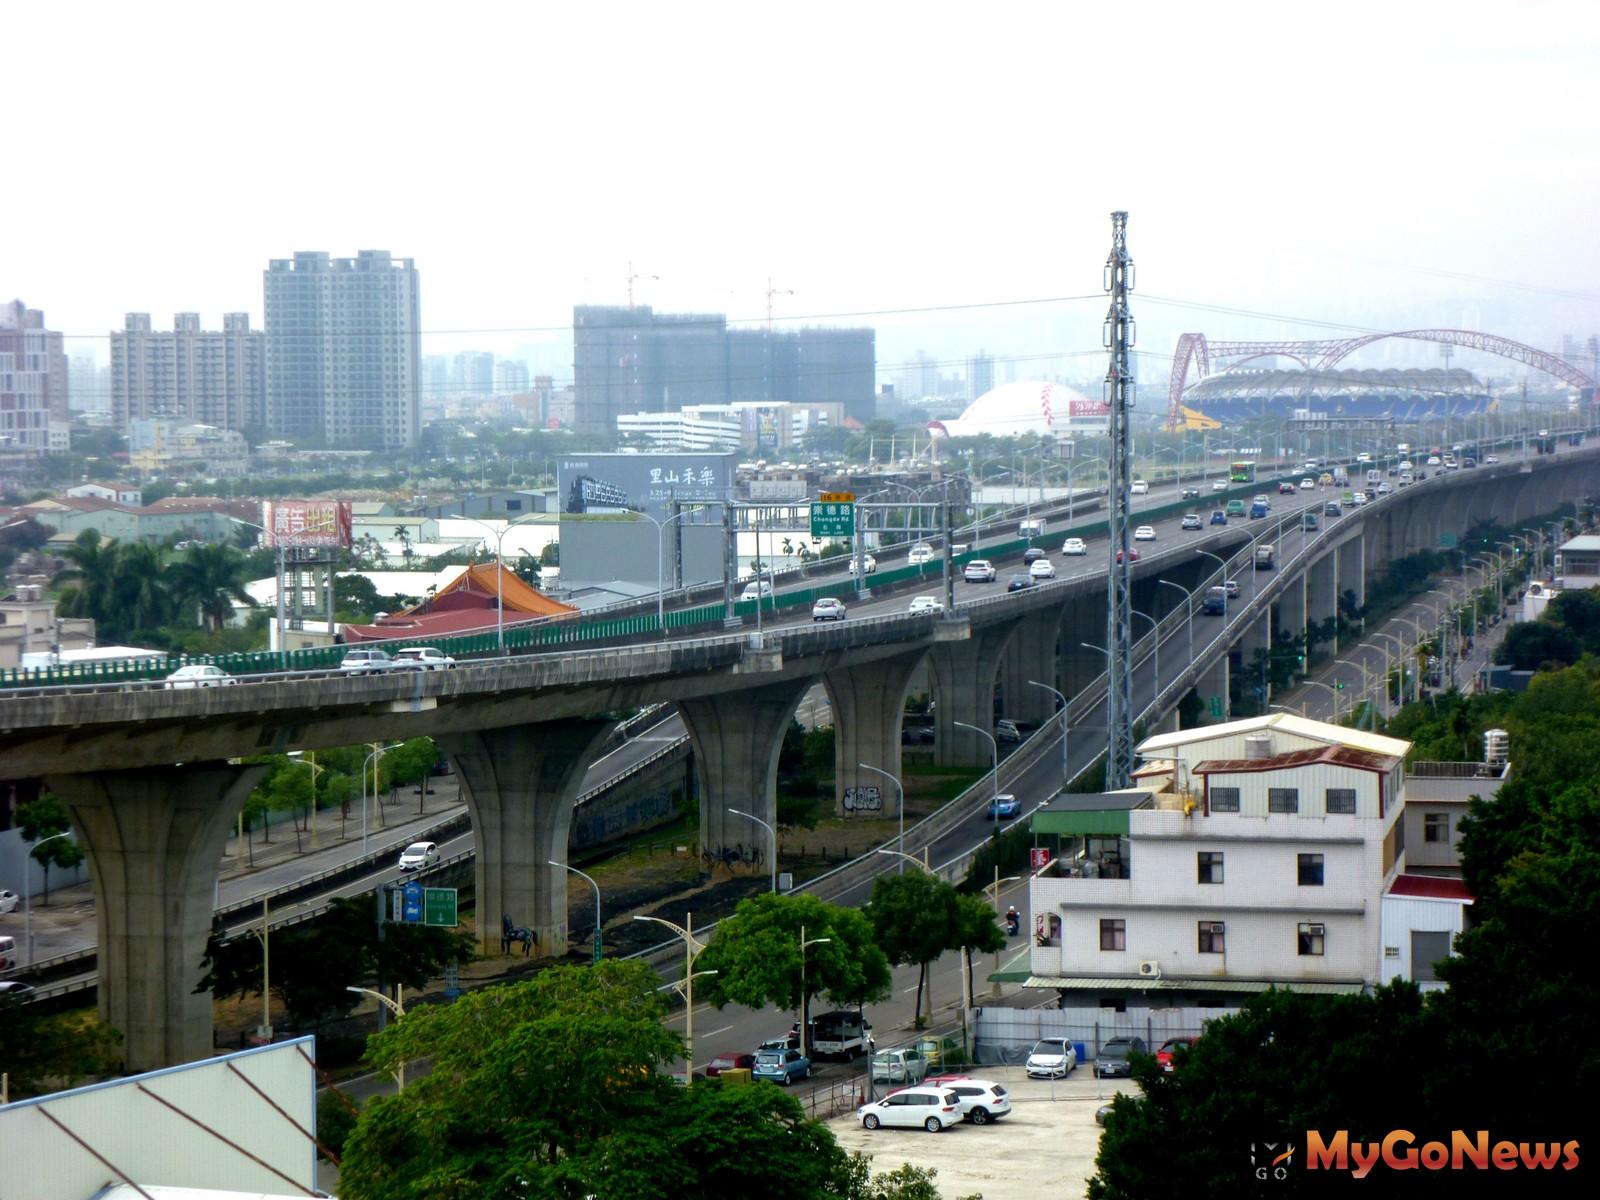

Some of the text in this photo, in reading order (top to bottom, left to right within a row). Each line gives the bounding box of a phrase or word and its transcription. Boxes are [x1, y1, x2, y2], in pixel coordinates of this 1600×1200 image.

[649, 466, 716, 487] 里山禾樂
[275, 505, 336, 533] 廣告出租
